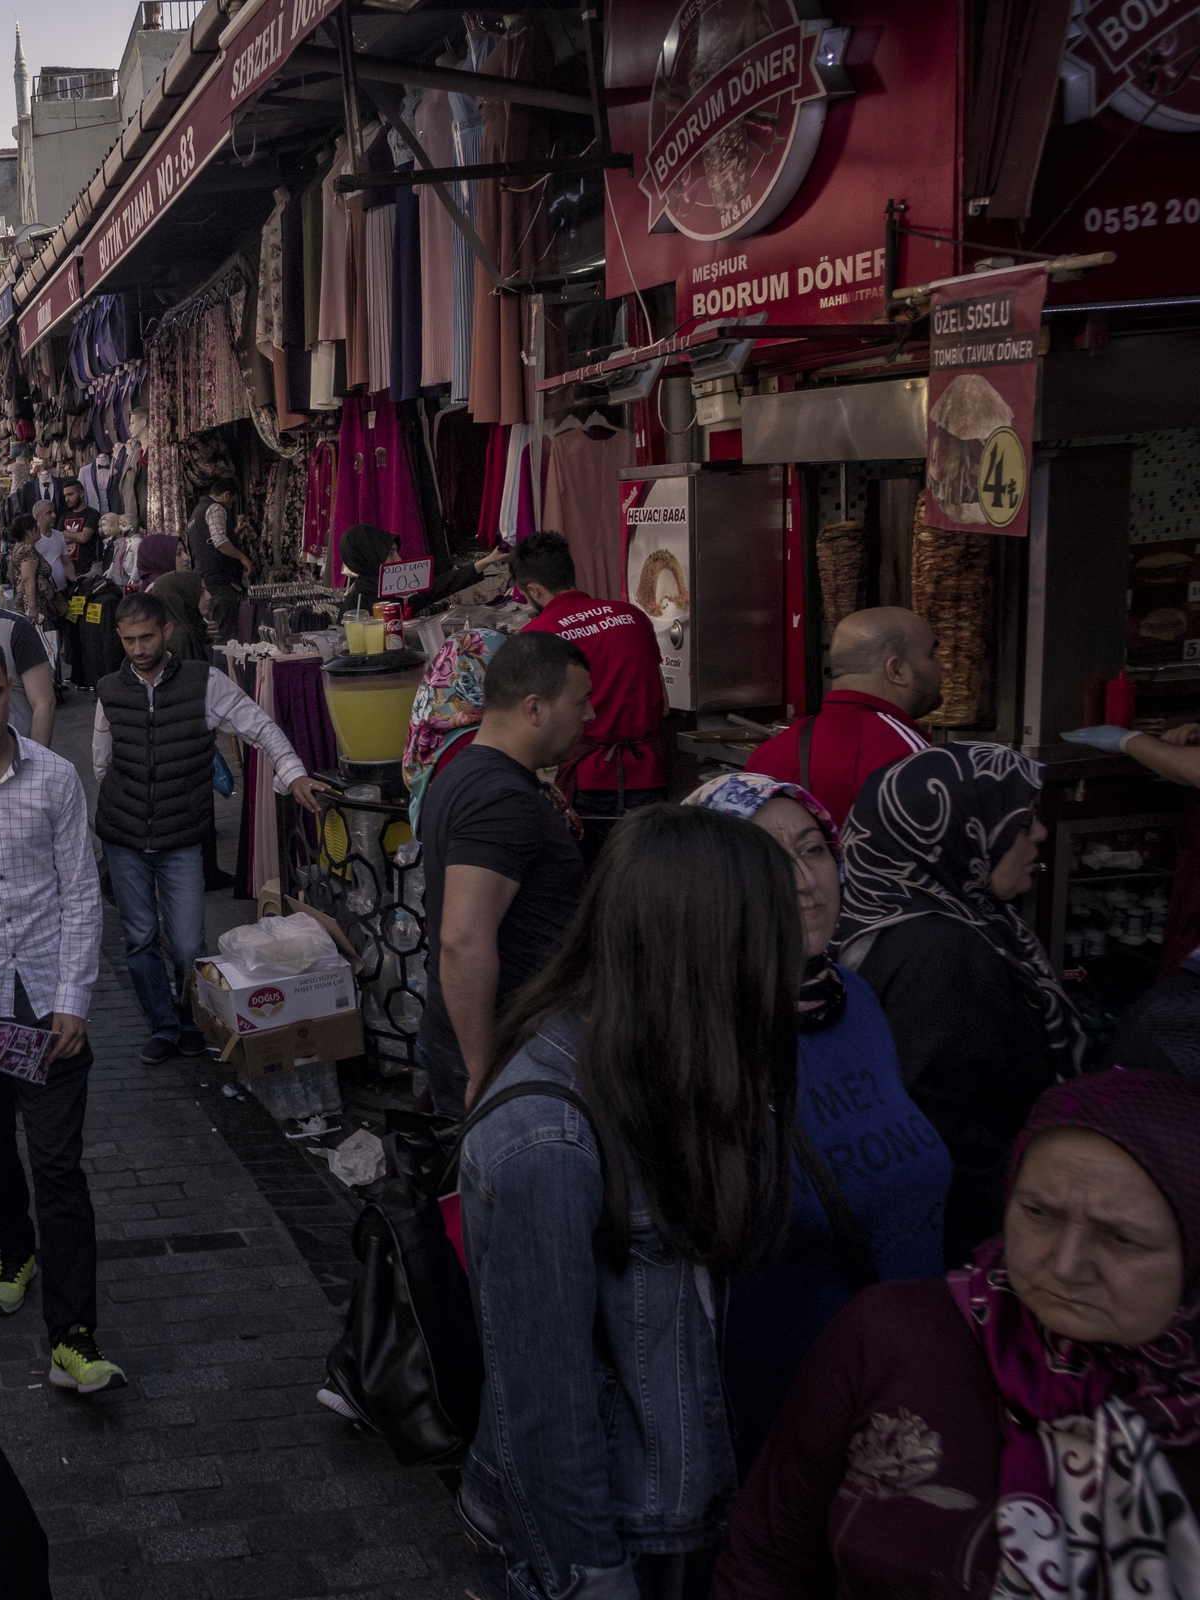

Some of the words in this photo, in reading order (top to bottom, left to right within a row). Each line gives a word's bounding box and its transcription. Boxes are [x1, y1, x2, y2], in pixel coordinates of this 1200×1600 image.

[654, 88, 726, 183] BODRUM
[727, 43, 796, 107] DÖNER
[99, 216, 124, 272] BUTİK
[122, 180, 154, 244] TUANA
[1083, 201, 1158, 234] 0552
[692, 254, 748, 283] MEŞHUR
[692, 272, 790, 316] BODRUM
[934, 305, 964, 334] ÖZEL
[966, 300, 1010, 330] SOSLU
[934, 344, 965, 366] TOMBİK
[966, 343, 996, 363] TAVUK
[996, 337, 1033, 360] DÖNER
[627, 509, 662, 523] HELVACI
[662, 507, 686, 522] BABA
[556, 623, 601, 641] ODRUM
[599, 613, 636, 630] DÖNER
[558, 605, 614, 628] MEŞHUR
[333, 977, 345, 986] ÇAY
[251, 992, 281, 1005] DOĞUŞ
[808, 1113, 939, 1189] RONG
